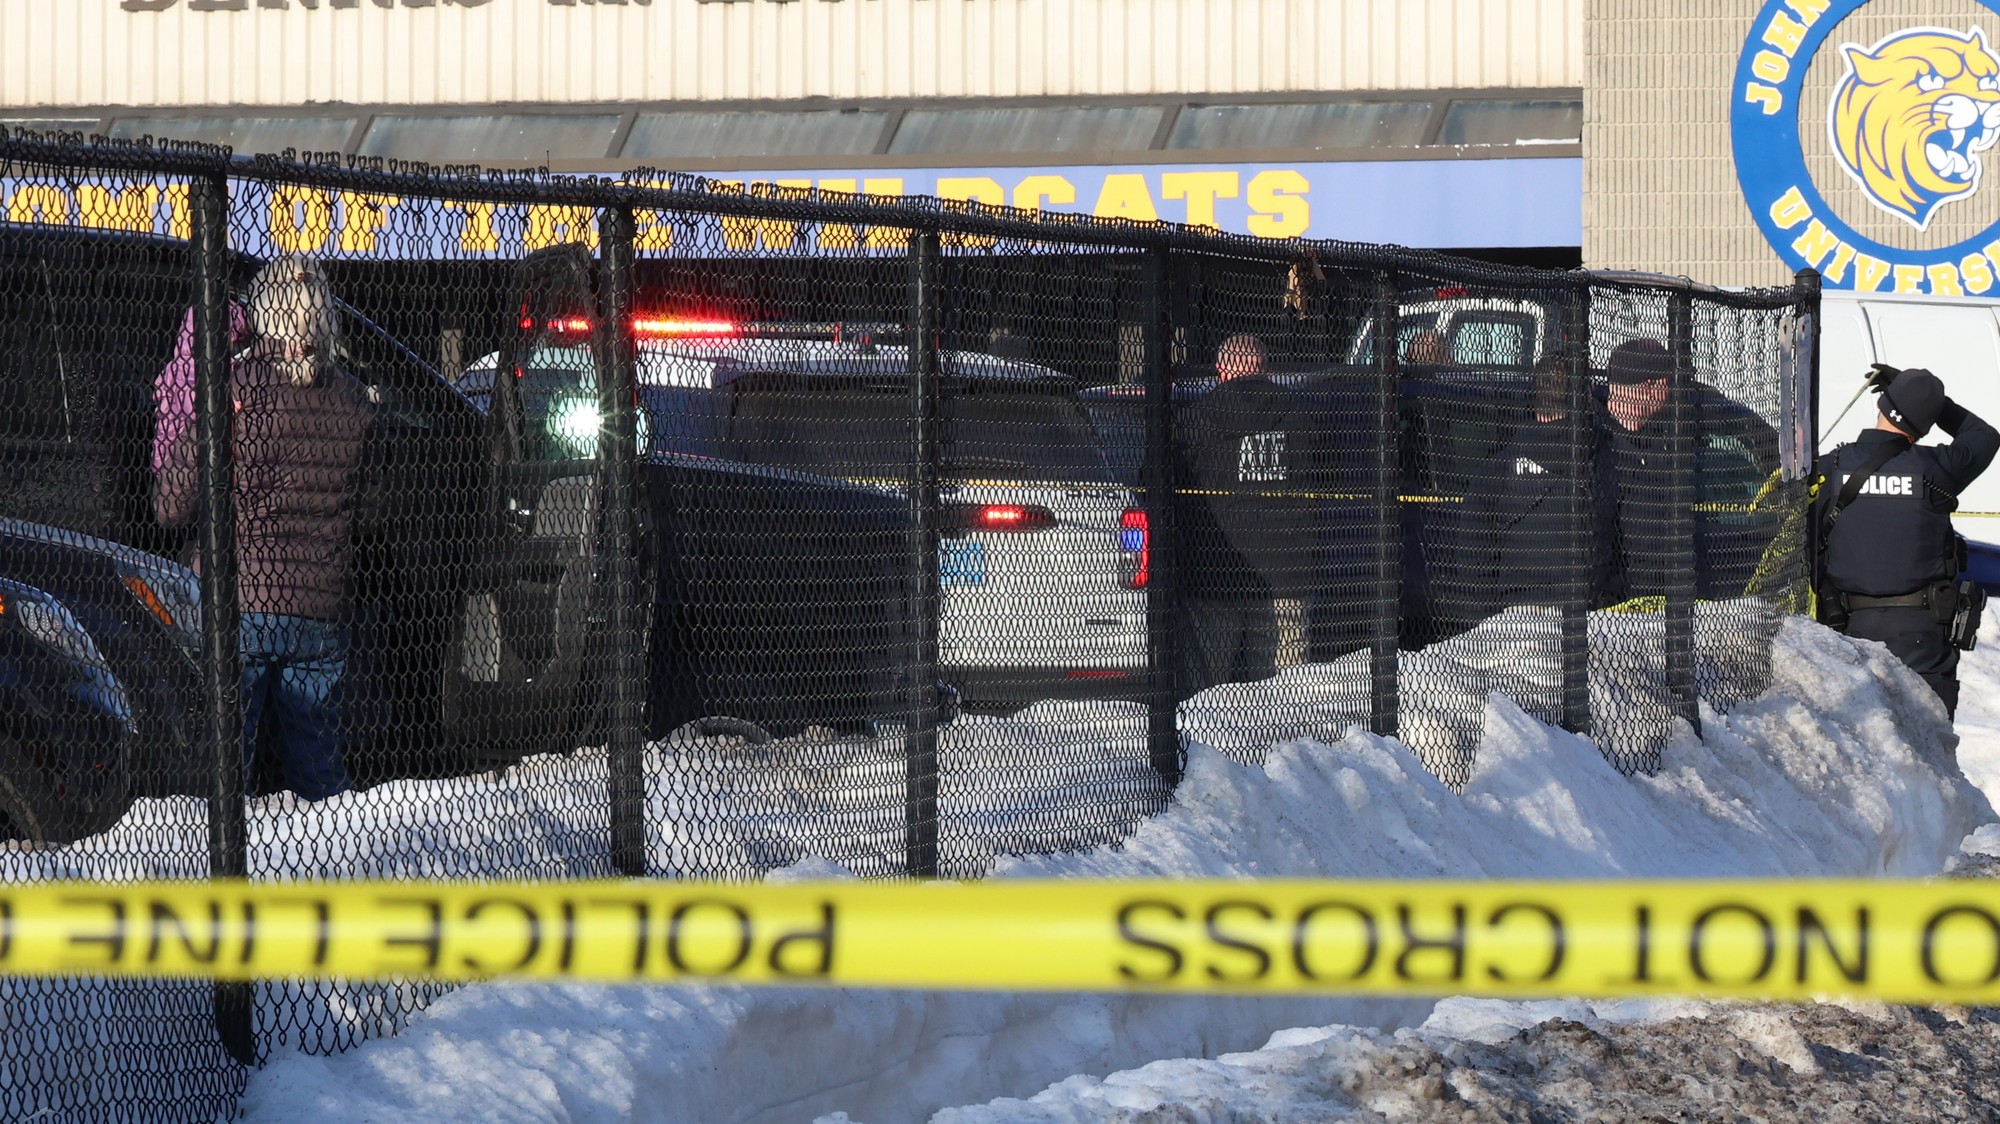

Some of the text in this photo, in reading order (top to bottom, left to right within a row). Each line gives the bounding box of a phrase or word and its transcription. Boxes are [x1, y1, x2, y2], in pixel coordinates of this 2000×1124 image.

[267, 185, 402, 252] OF
[711, 170, 1310, 250] WILDCATS
[57, 896, 331, 969] LINE
[372, 896, 835, 978] POLICE
[1114, 899, 1568, 982] CROSS
[1604, 902, 1870, 986] NOT
